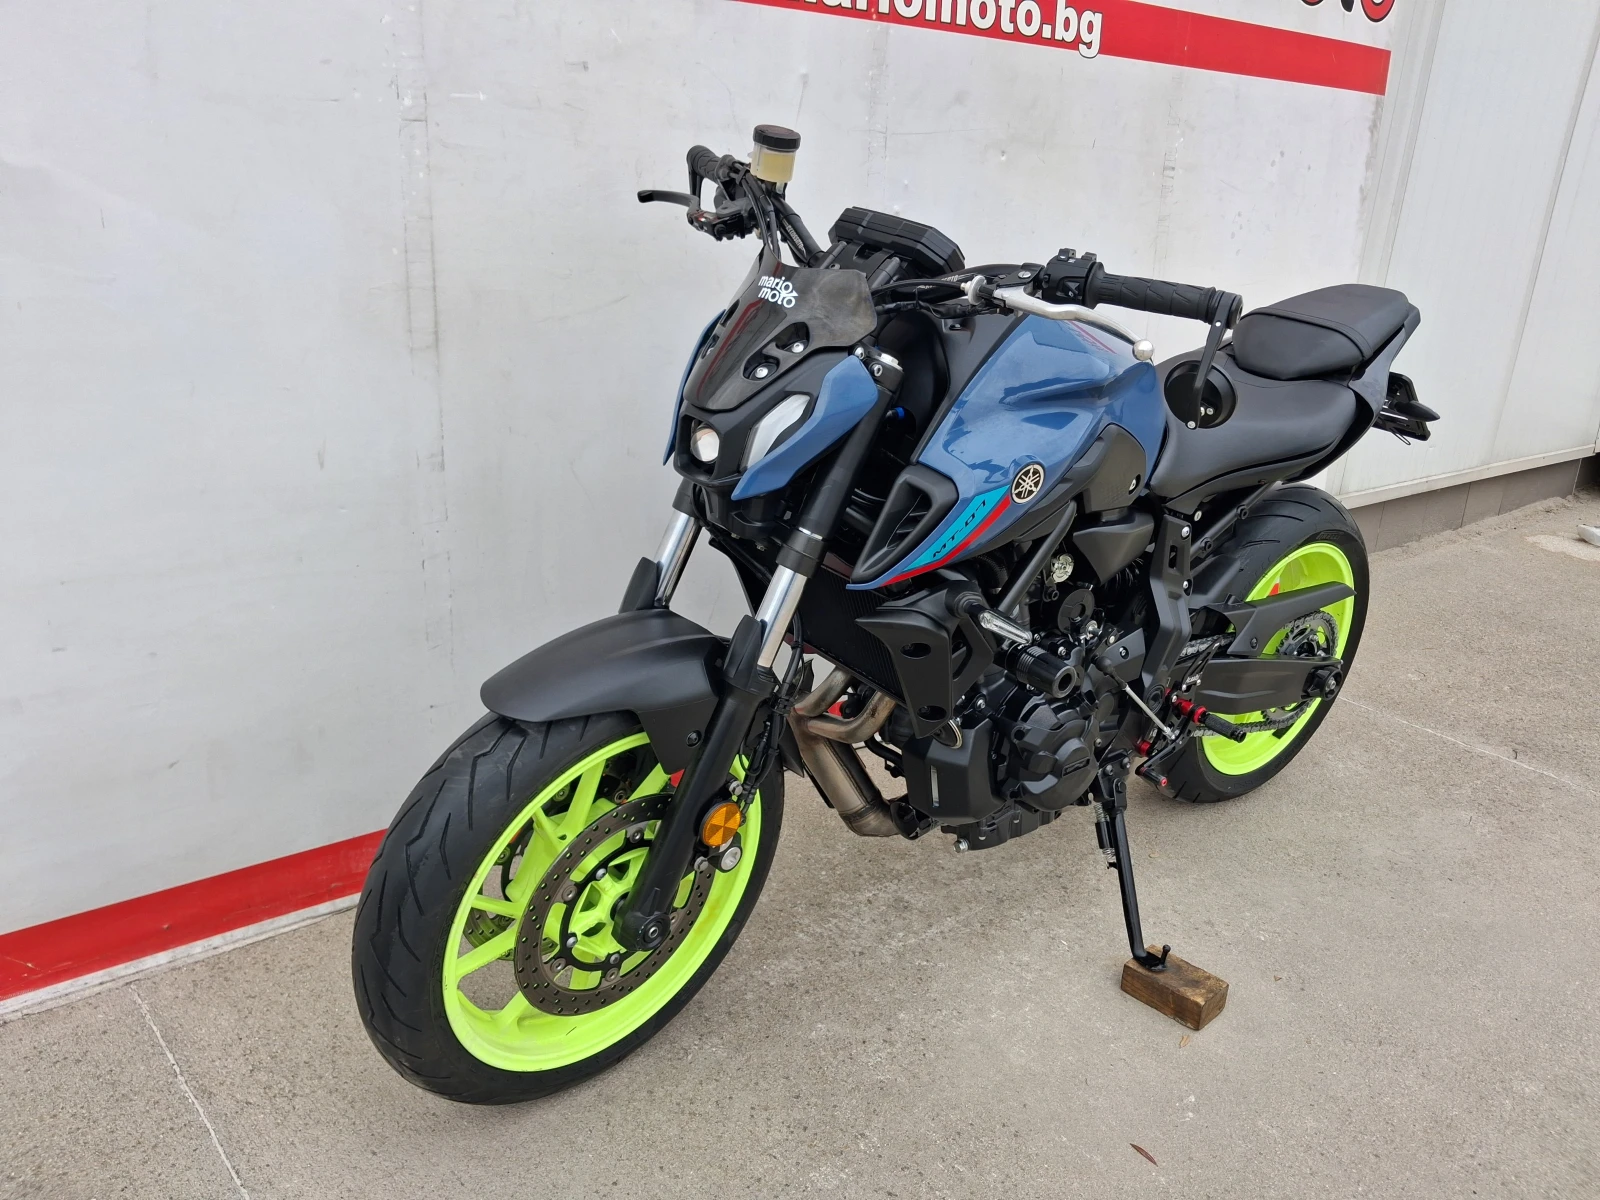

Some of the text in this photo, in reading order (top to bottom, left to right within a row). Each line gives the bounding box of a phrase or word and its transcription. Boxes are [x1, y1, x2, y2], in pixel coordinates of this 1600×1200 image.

[789, 0, 1103, 59] omoto.bg
[758, 276, 793, 294] mario
[758, 288, 797, 309] moto
[932, 499, 986, 558] MT-07
